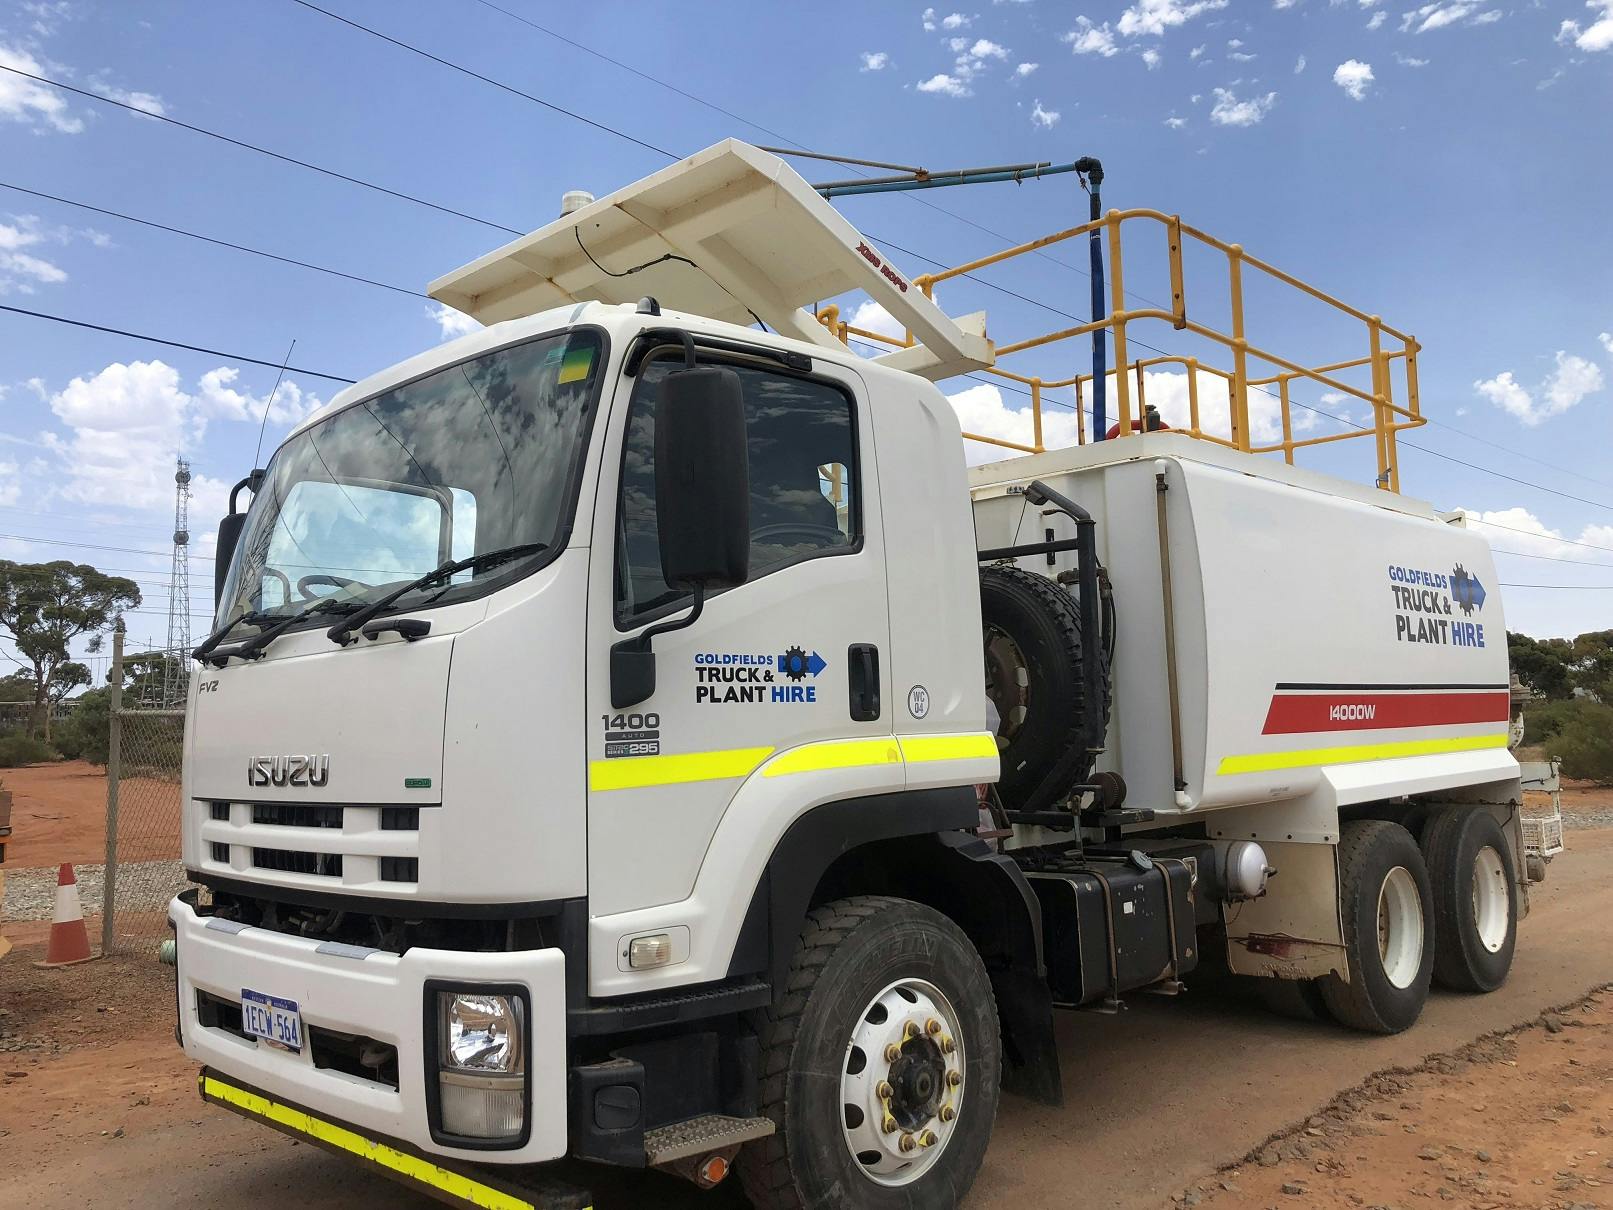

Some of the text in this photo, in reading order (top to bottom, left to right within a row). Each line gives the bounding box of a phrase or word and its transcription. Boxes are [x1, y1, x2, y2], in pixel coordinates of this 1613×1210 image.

[880, 264, 908, 293] ROPS
[1388, 565, 1448, 589] GOLDFIELDS
[1391, 585, 1452, 615] TRUCK &
[1395, 614, 1485, 648] PLANT HIRE
[694, 653, 774, 665] GOLDFIELDS
[695, 667, 774, 683] TRUCK &
[696, 685, 817, 703] PLANT HIRE
[913, 691, 925, 702] WC
[1329, 704, 1376, 721] 14000W
[601, 713, 660, 731] 1400
[629, 742, 658, 754] 295
[248, 754, 330, 787] ISUZU
